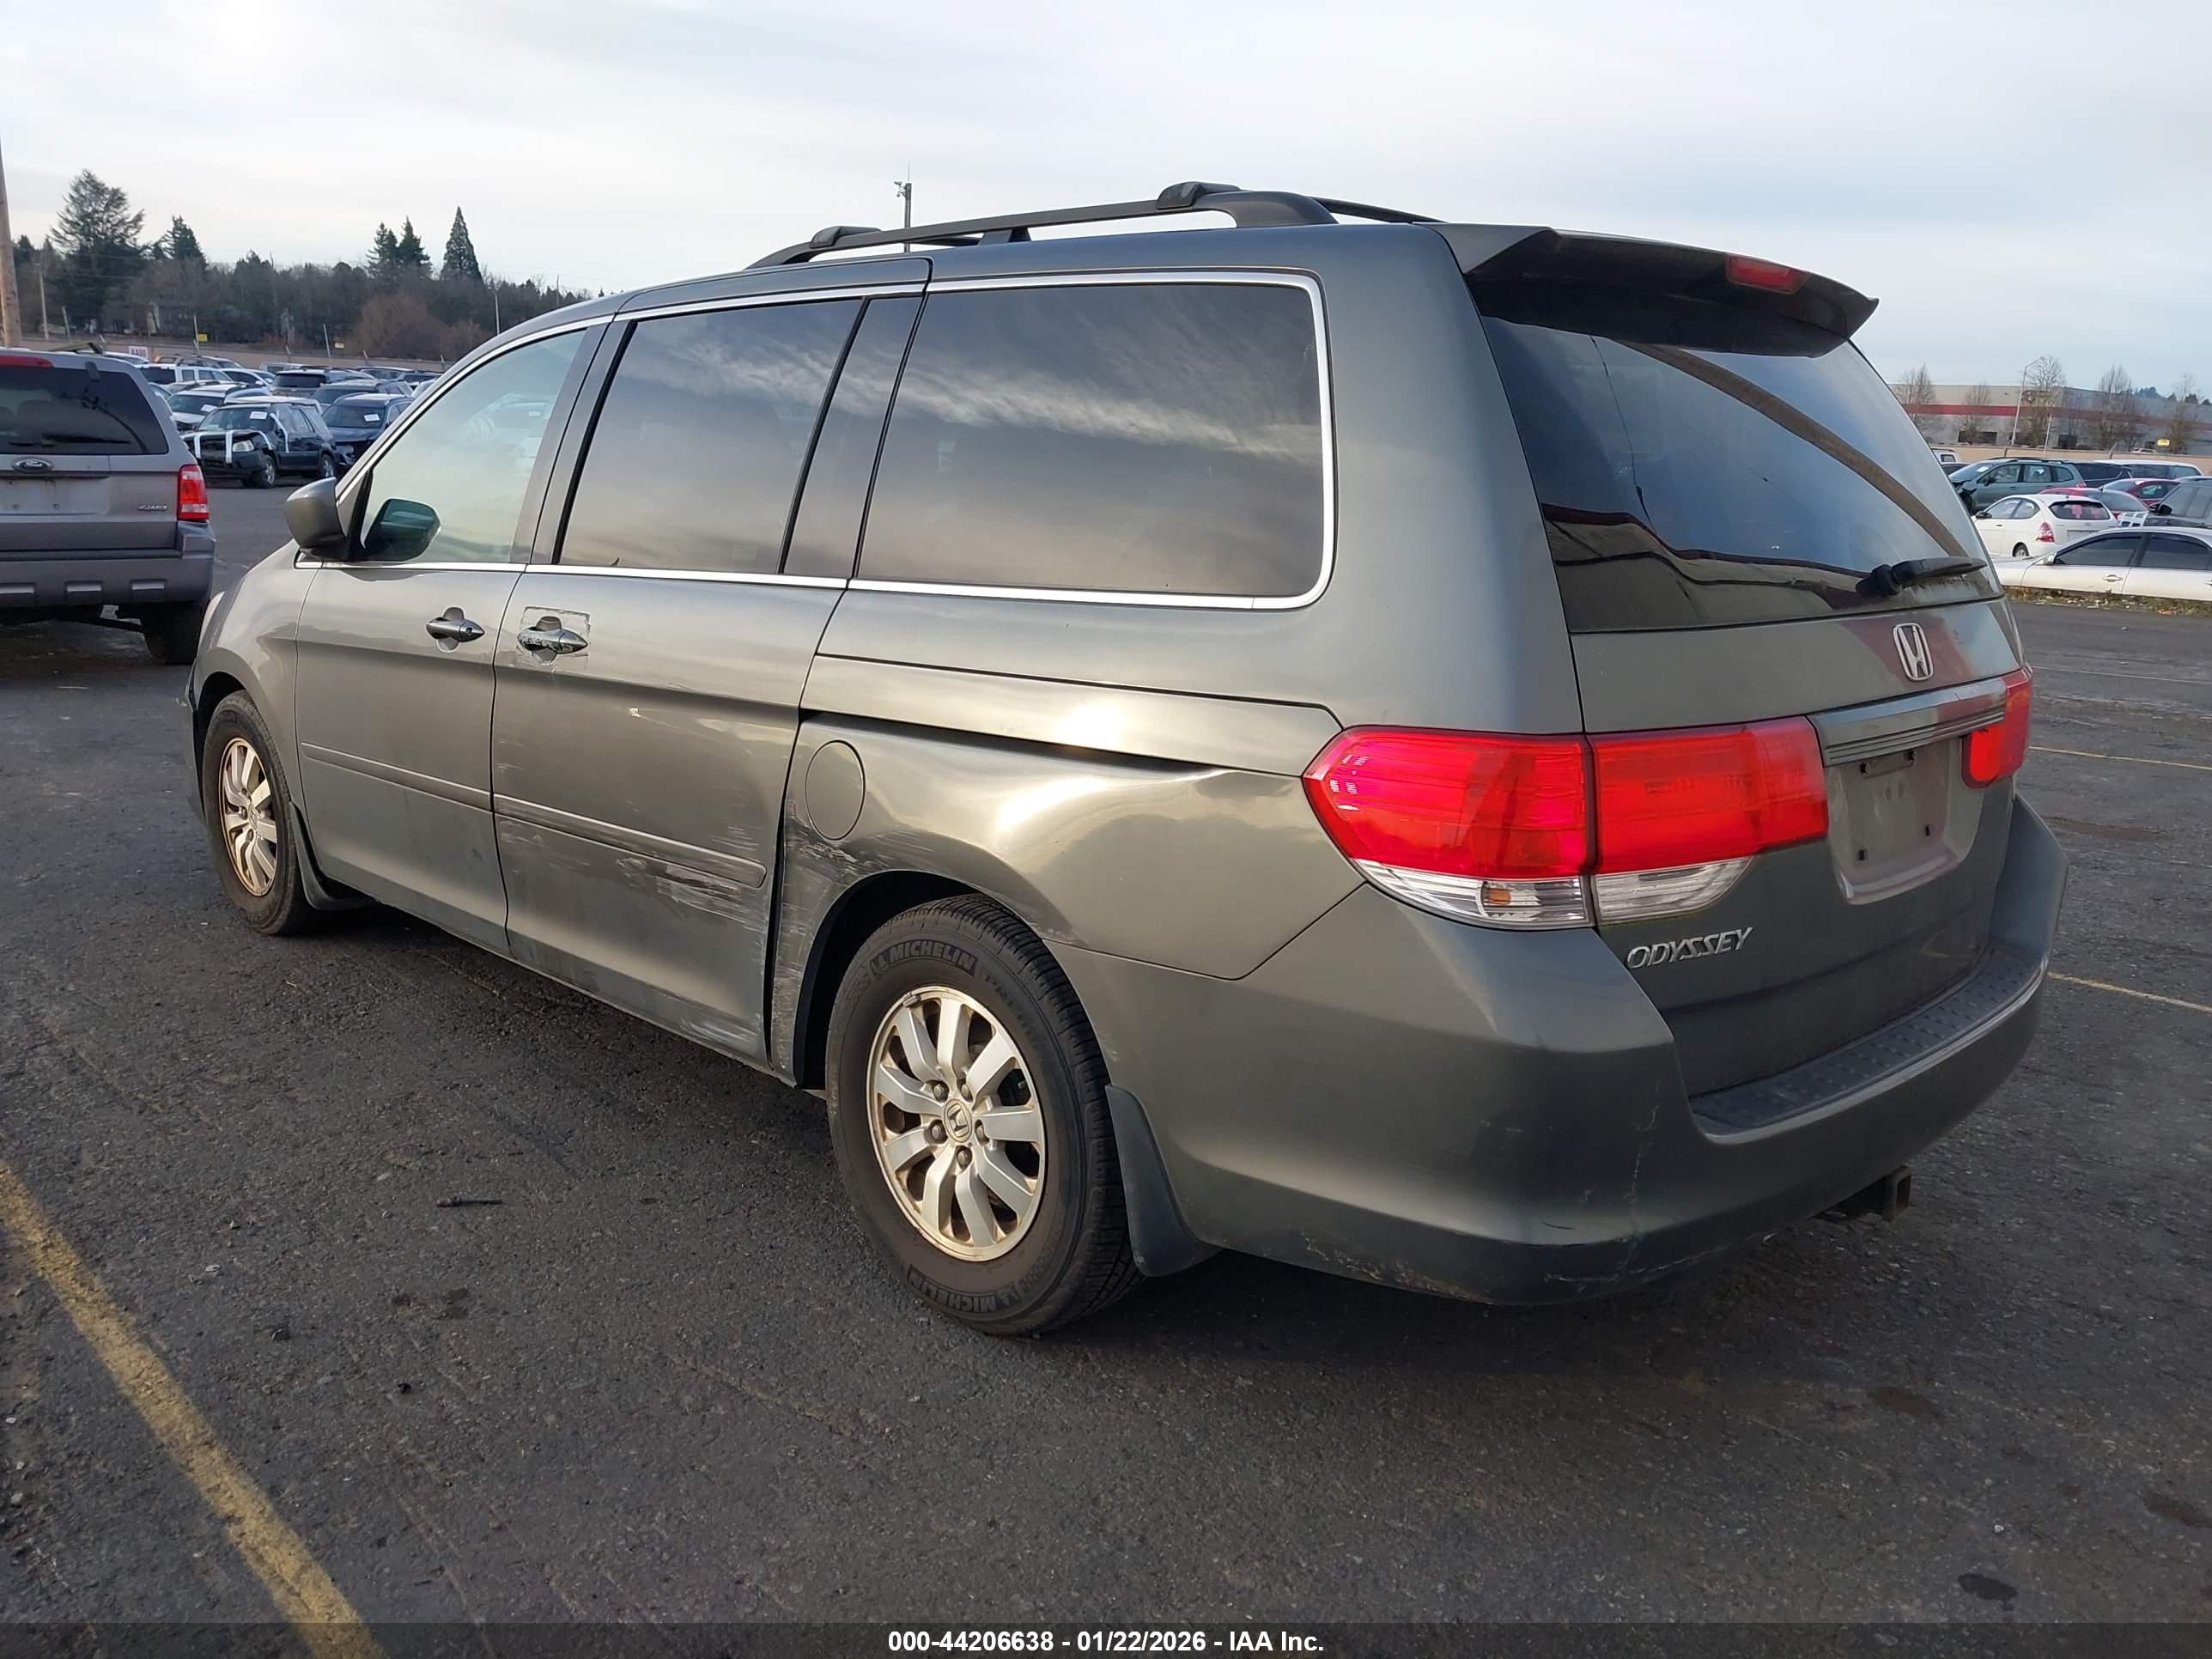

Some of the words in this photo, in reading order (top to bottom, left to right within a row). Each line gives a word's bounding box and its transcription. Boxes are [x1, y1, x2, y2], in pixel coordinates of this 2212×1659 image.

[890, 939, 976, 971] MICHELIN
[1626, 927, 1754, 969] ODYSSEY
[908, 1270, 997, 1313] MICHELIN
